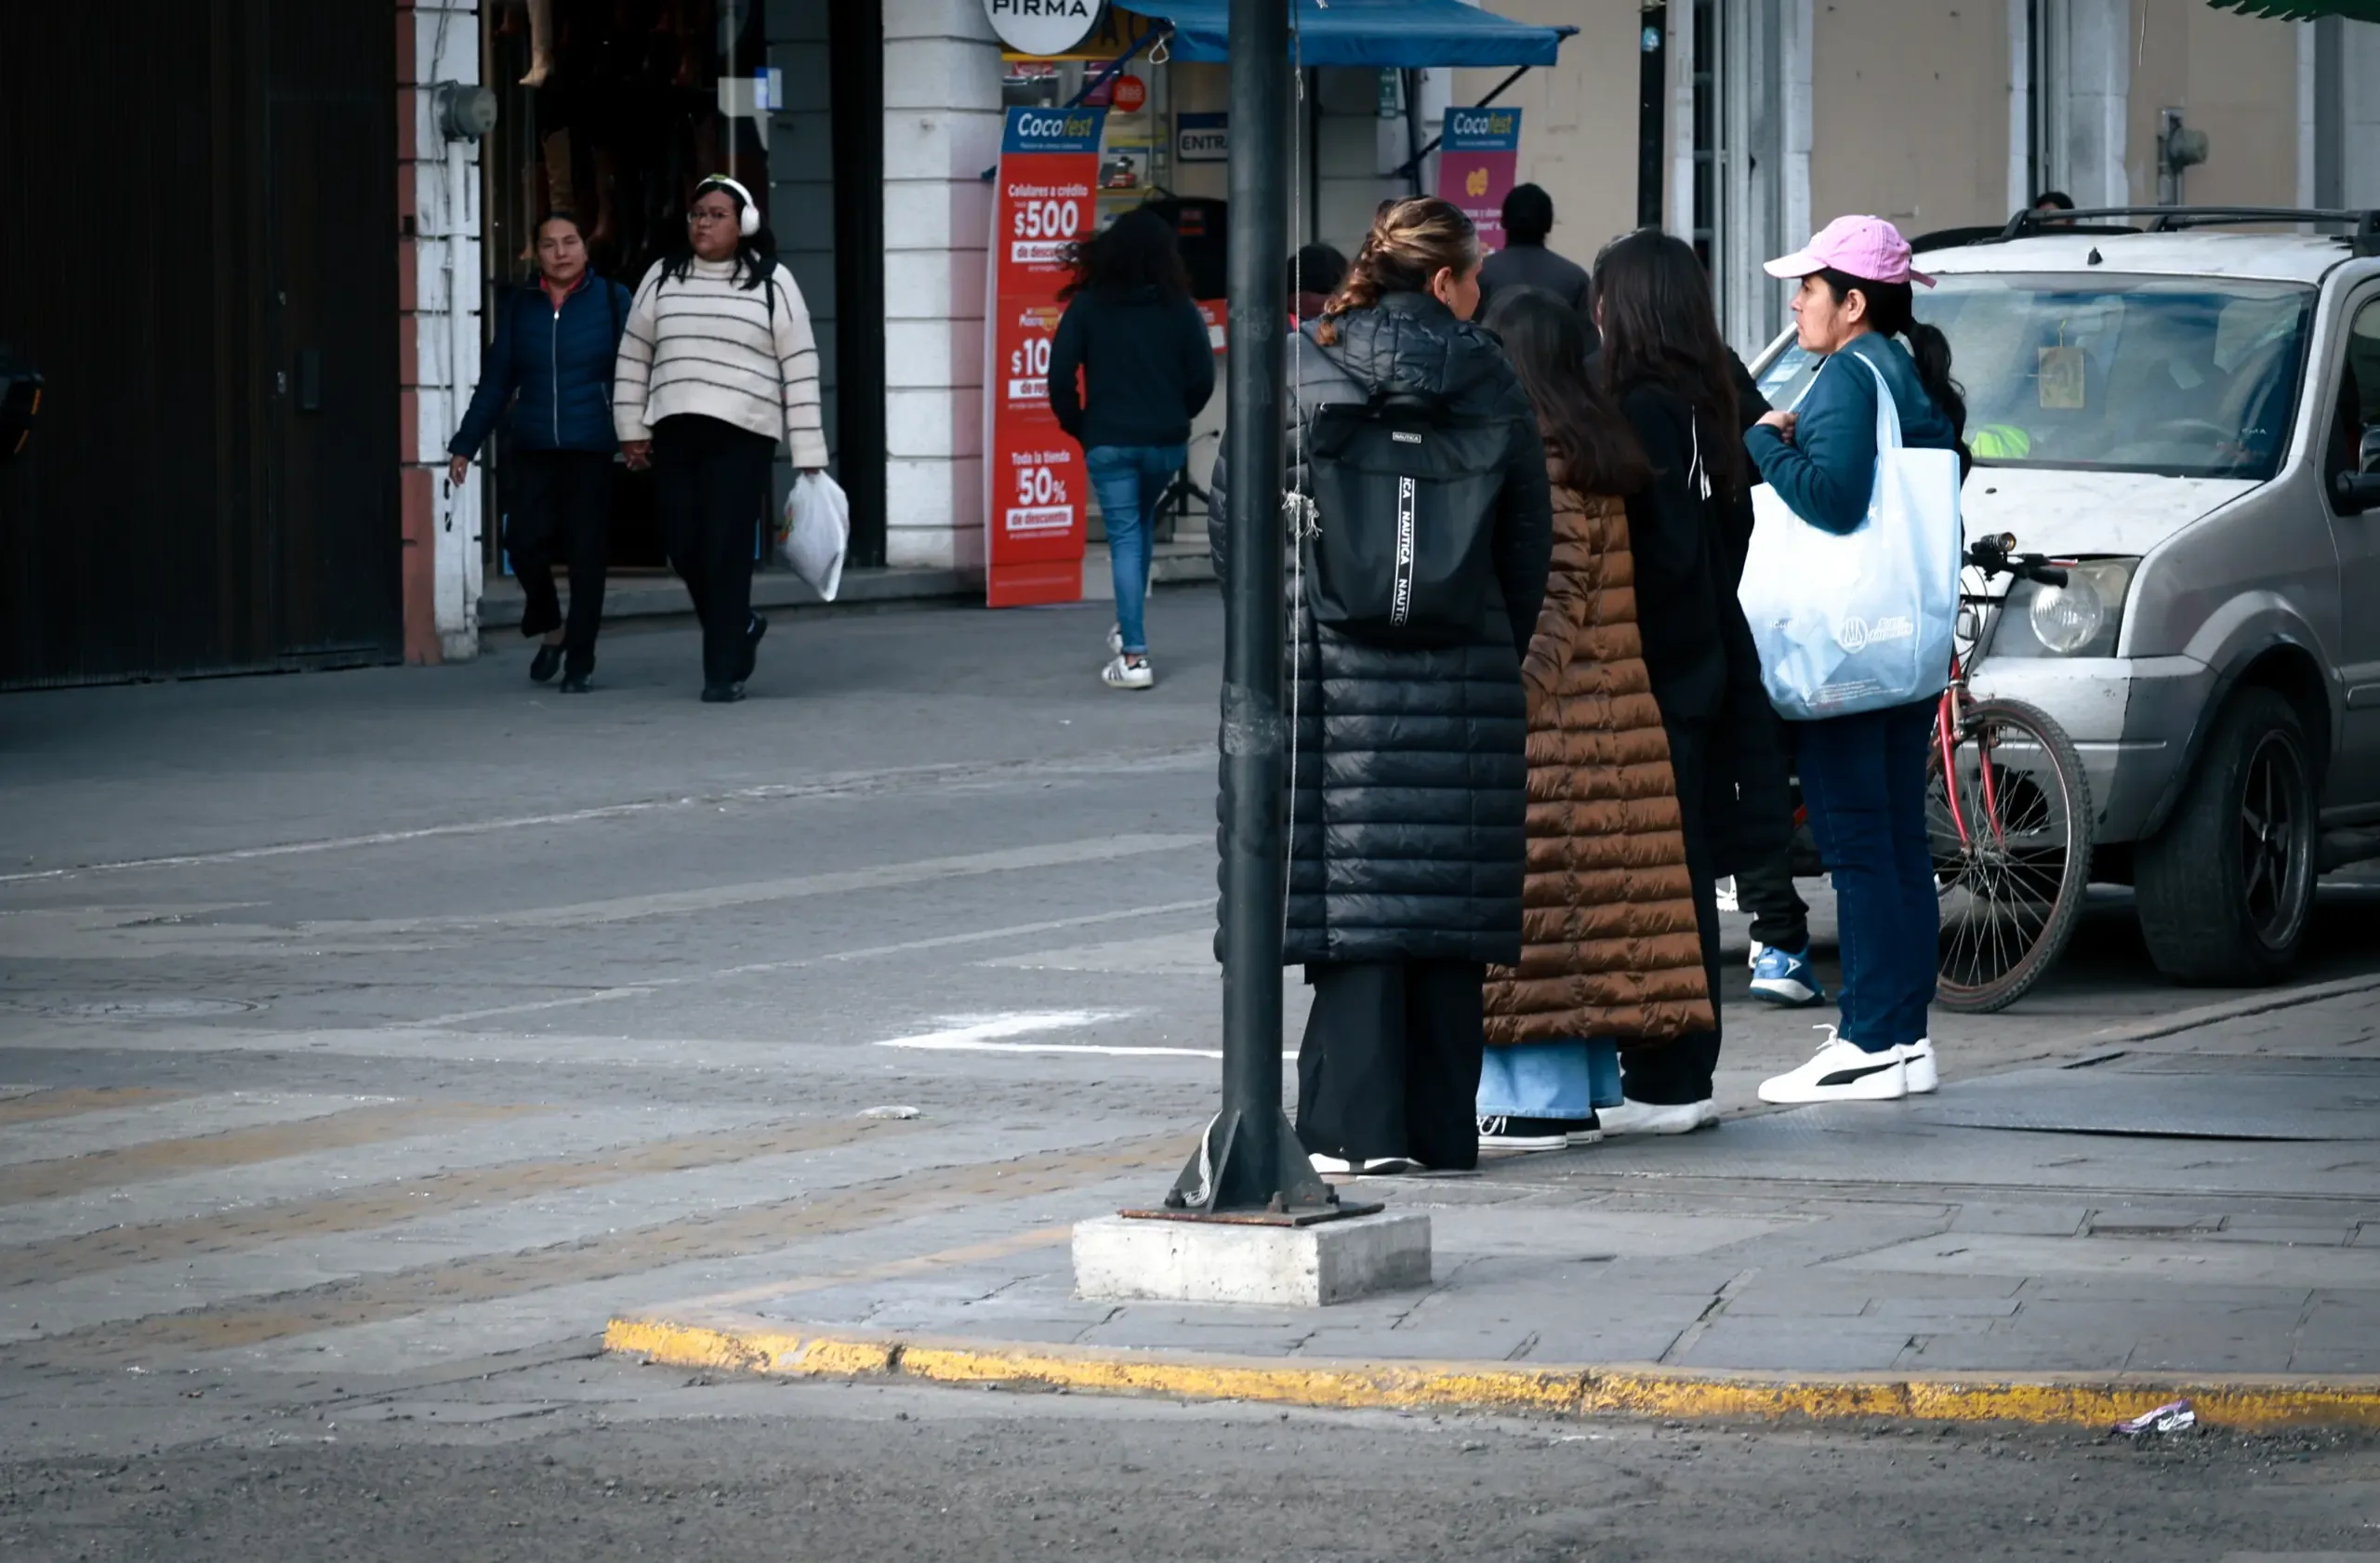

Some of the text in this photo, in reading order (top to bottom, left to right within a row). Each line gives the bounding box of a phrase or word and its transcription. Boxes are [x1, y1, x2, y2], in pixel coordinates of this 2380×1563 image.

[993, 0, 1088, 17] PIRMA
[1017, 113, 1093, 138] Cocofest
[1453, 112, 1513, 135] Cocofest
[1008, 183, 1048, 198] Celulares
[1013, 199, 1078, 238] $500
[1012, 452, 1032, 466] Toda
[1043, 449, 1070, 463] tienda
[1018, 467, 1066, 505] 50%
[1025, 510, 1068, 525] descuento
[1400, 510, 1411, 565] NAUTICA
